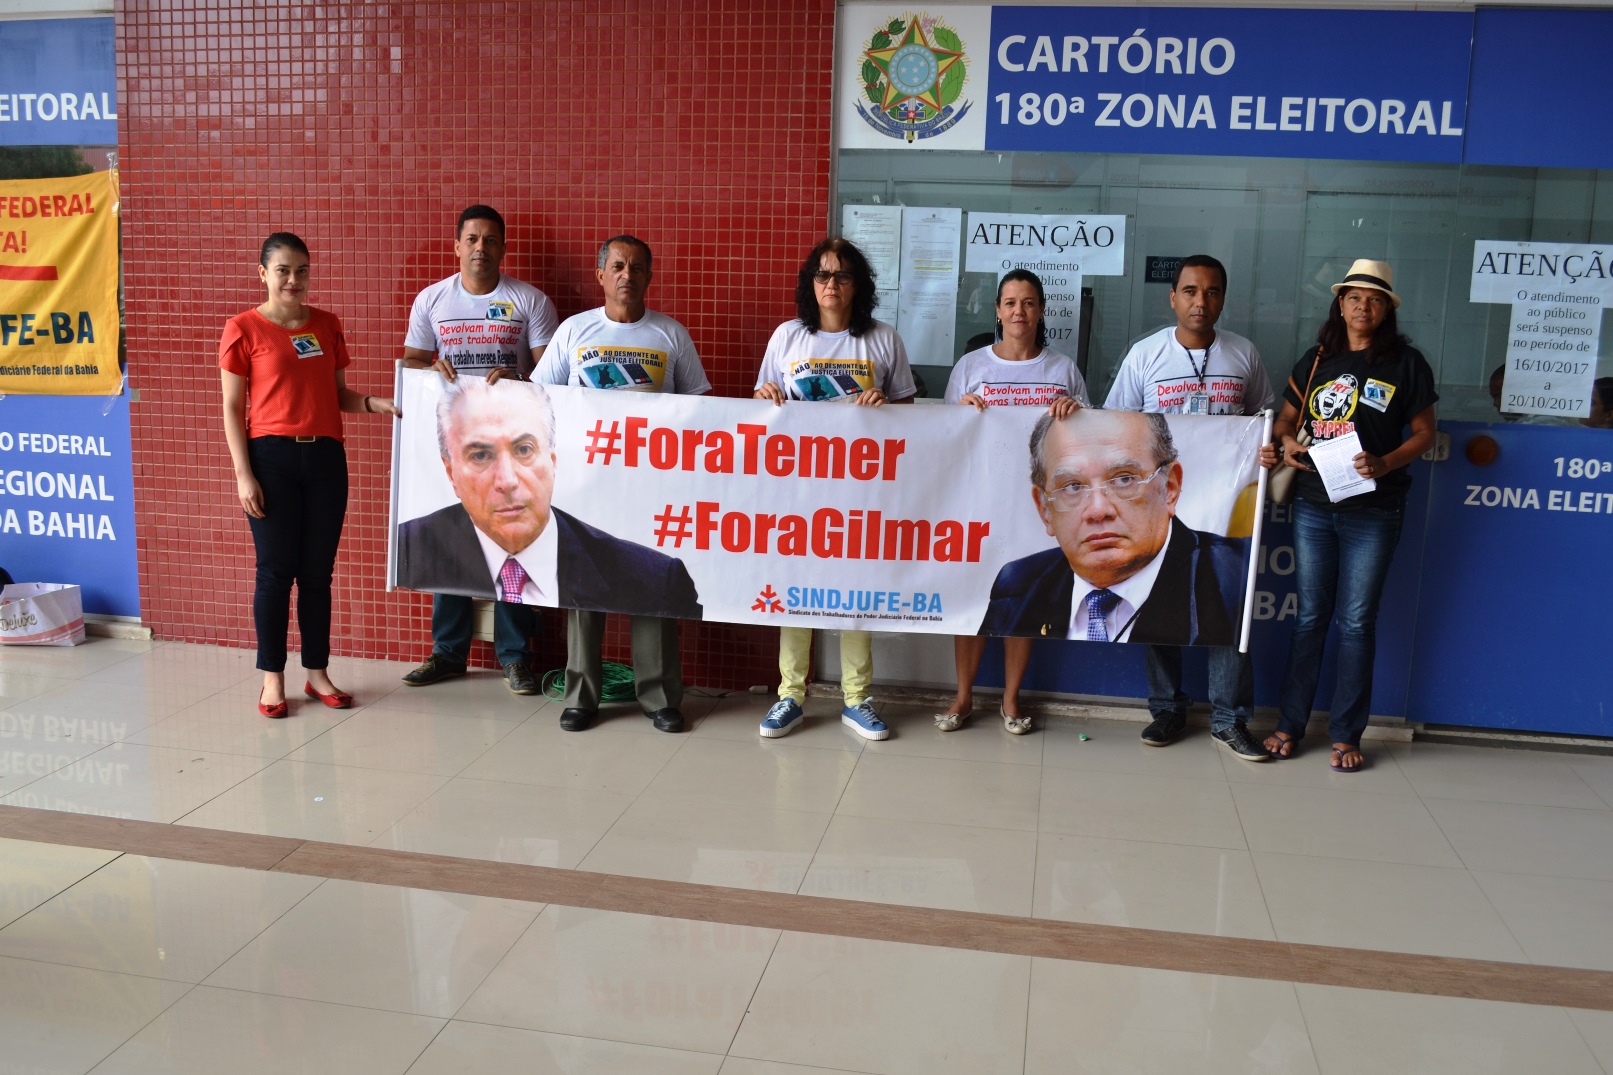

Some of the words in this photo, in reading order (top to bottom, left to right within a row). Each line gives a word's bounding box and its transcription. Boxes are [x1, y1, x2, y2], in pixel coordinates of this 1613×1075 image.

[997, 28, 1236, 75] CARTÓRIO
[1094, 93, 1217, 130] ZONA
[1230, 95, 1463, 136] ELEITORAL
[0, 192, 95, 218] FEDERAL
[970, 220, 1115, 253] ATENÇÃO
[1002, 259, 1012, 270] O
[1014, 258, 1080, 272] atendimento
[1152, 260, 1180, 268] CARTÓ
[1475, 250, 1613, 284] ATENÇÃ
[1040, 274, 1067, 286] blico
[1152, 270, 1174, 278] ELEIT
[1044, 292, 1075, 304] penso
[1517, 290, 1528, 300] O
[1530, 291, 1600, 305] atendimento
[1060, 307, 1073, 318] de
[1527, 308, 1541, 317] ao
[1544, 308, 1586, 320] público
[440, 322, 484, 336] Devolvam
[1516, 322, 1540, 333] será
[1542, 326, 1593, 337] suspenso
[1513, 338, 1528, 348] no
[1530, 338, 1574, 352] período
[1576, 341, 1590, 352] de
[453, 350, 475, 366] trabalho
[476, 352, 497, 365] merece
[582, 350, 600, 362] NÃO
[614, 350, 649, 359] DESMONTE
[600, 356, 628, 364] JUSTIÇA
[32, 364, 62, 376] Federal
[64, 364, 74, 376] da
[75, 364, 99, 375] Bahia
[794, 362, 811, 375] NÃO
[1514, 358, 1590, 376] 16/10/2017
[984, 385, 1031, 396] Devolvam
[1158, 380, 1207, 396] Devolvam
[1211, 379, 1244, 392] minhas
[1544, 382, 1552, 391] a
[1158, 396, 1185, 408] horas
[1508, 394, 1584, 412] 20/10/2017
[18, 432, 112, 456] FEDERAL
[584, 416, 906, 481] #ForaTemer
[1464, 485, 1541, 510] ZONA
[28, 510, 116, 541] BAHIA
[654, 501, 990, 563] #ForaGilmar
[786, 586, 942, 614] SINDJUFE-BA
[822, 610, 856, 618] Trabalhadores
